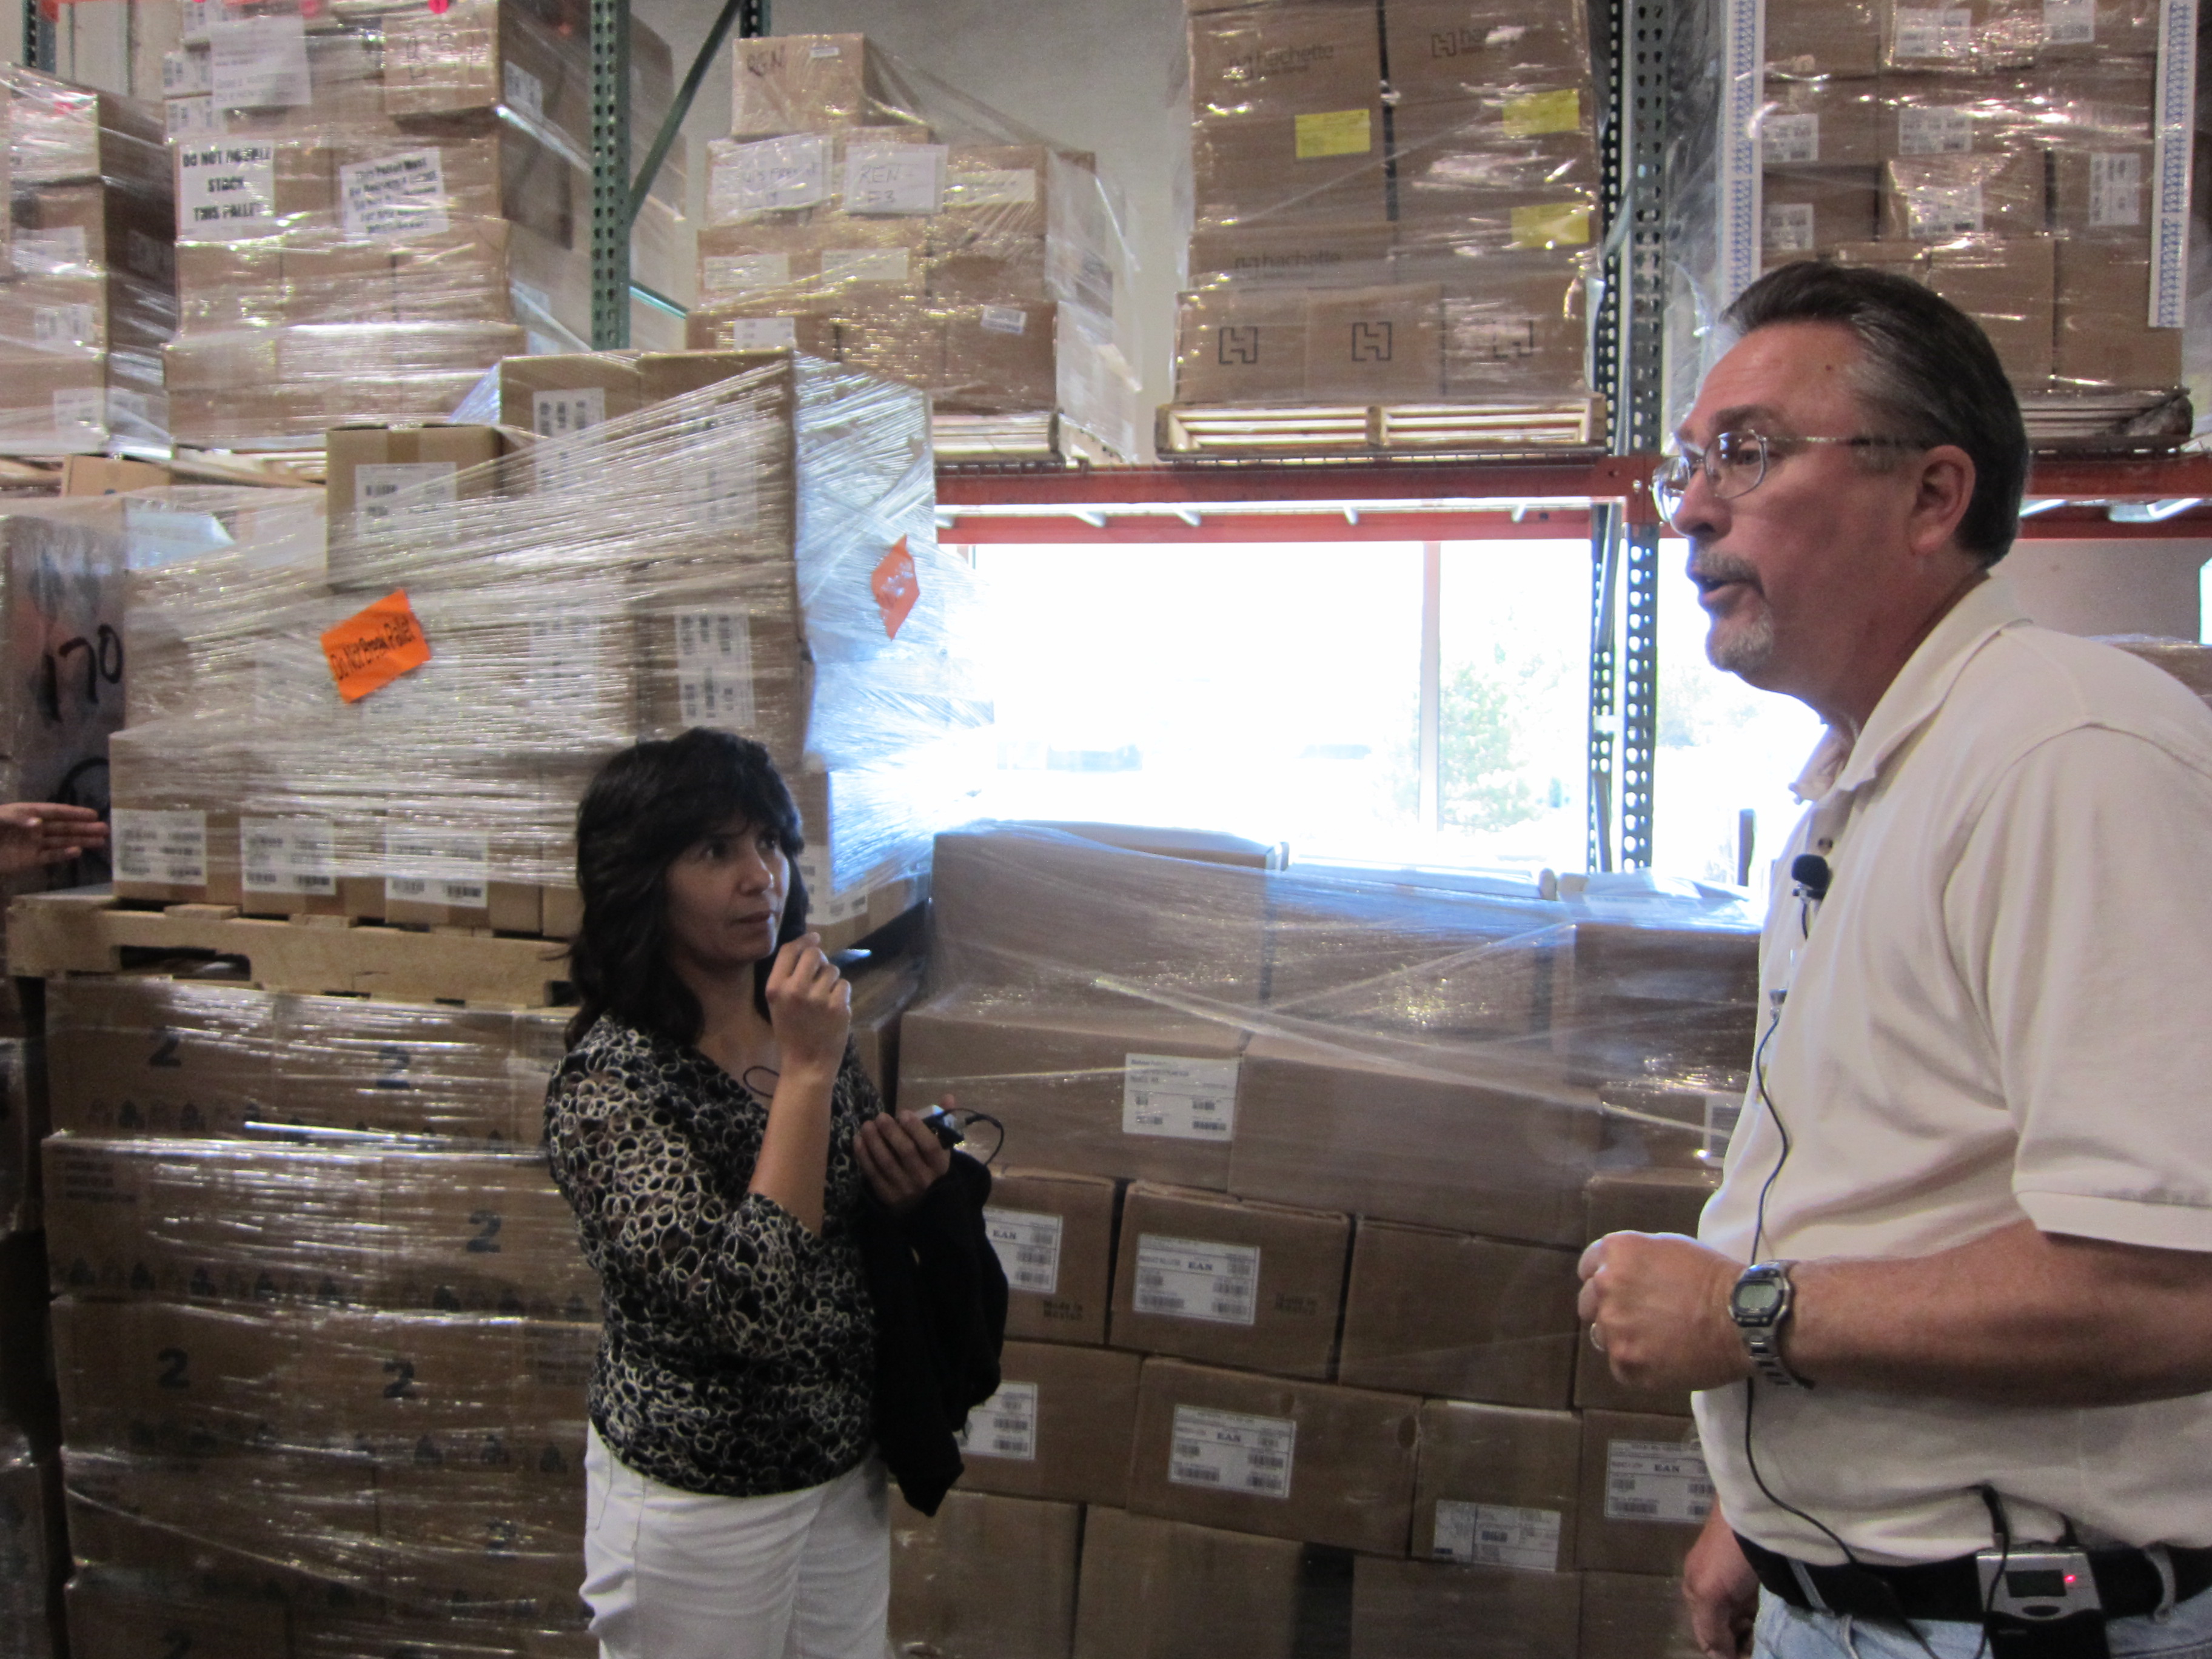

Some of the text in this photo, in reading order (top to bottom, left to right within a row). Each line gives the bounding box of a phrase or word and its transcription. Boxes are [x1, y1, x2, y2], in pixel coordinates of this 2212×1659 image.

[1256, 44, 1335, 67] hachette
[183, 153, 197, 167] DO
[201, 150, 222, 166] NOT
[148, 1030, 182, 1067] 2
[377, 1045, 411, 1089] 2
[466, 1210, 502, 1253] 2
[993, 1229, 1017, 1240] EAN
[1187, 1261, 1213, 1272] EAN
[156, 1347, 190, 1389] 2
[383, 1358, 418, 1399] 2
[1654, 1463, 1680, 1473] EAN
